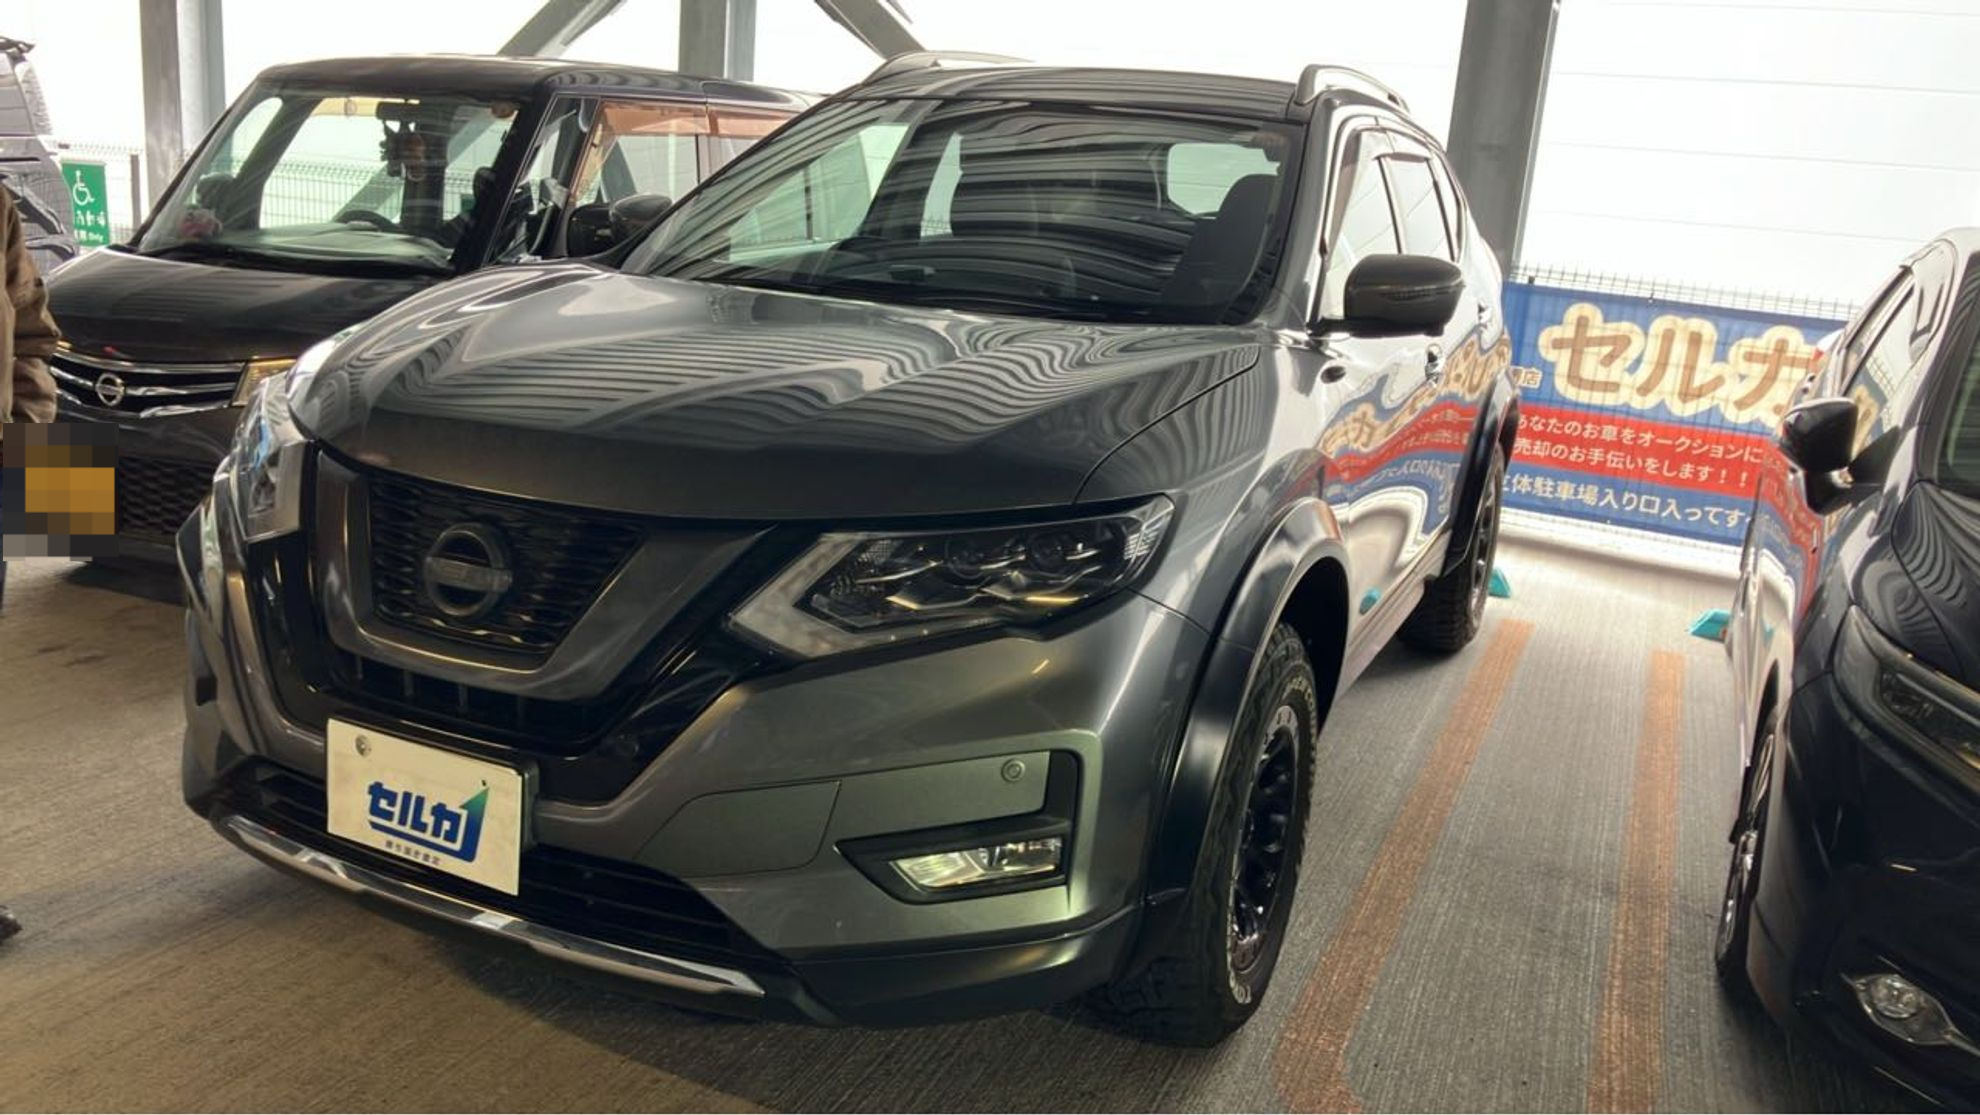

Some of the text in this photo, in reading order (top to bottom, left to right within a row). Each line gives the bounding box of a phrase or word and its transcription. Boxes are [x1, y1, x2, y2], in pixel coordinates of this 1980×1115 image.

[1503, 473, 1751, 528] 体駐車場入り口入ってす
[367, 780, 463, 845] セルカ
